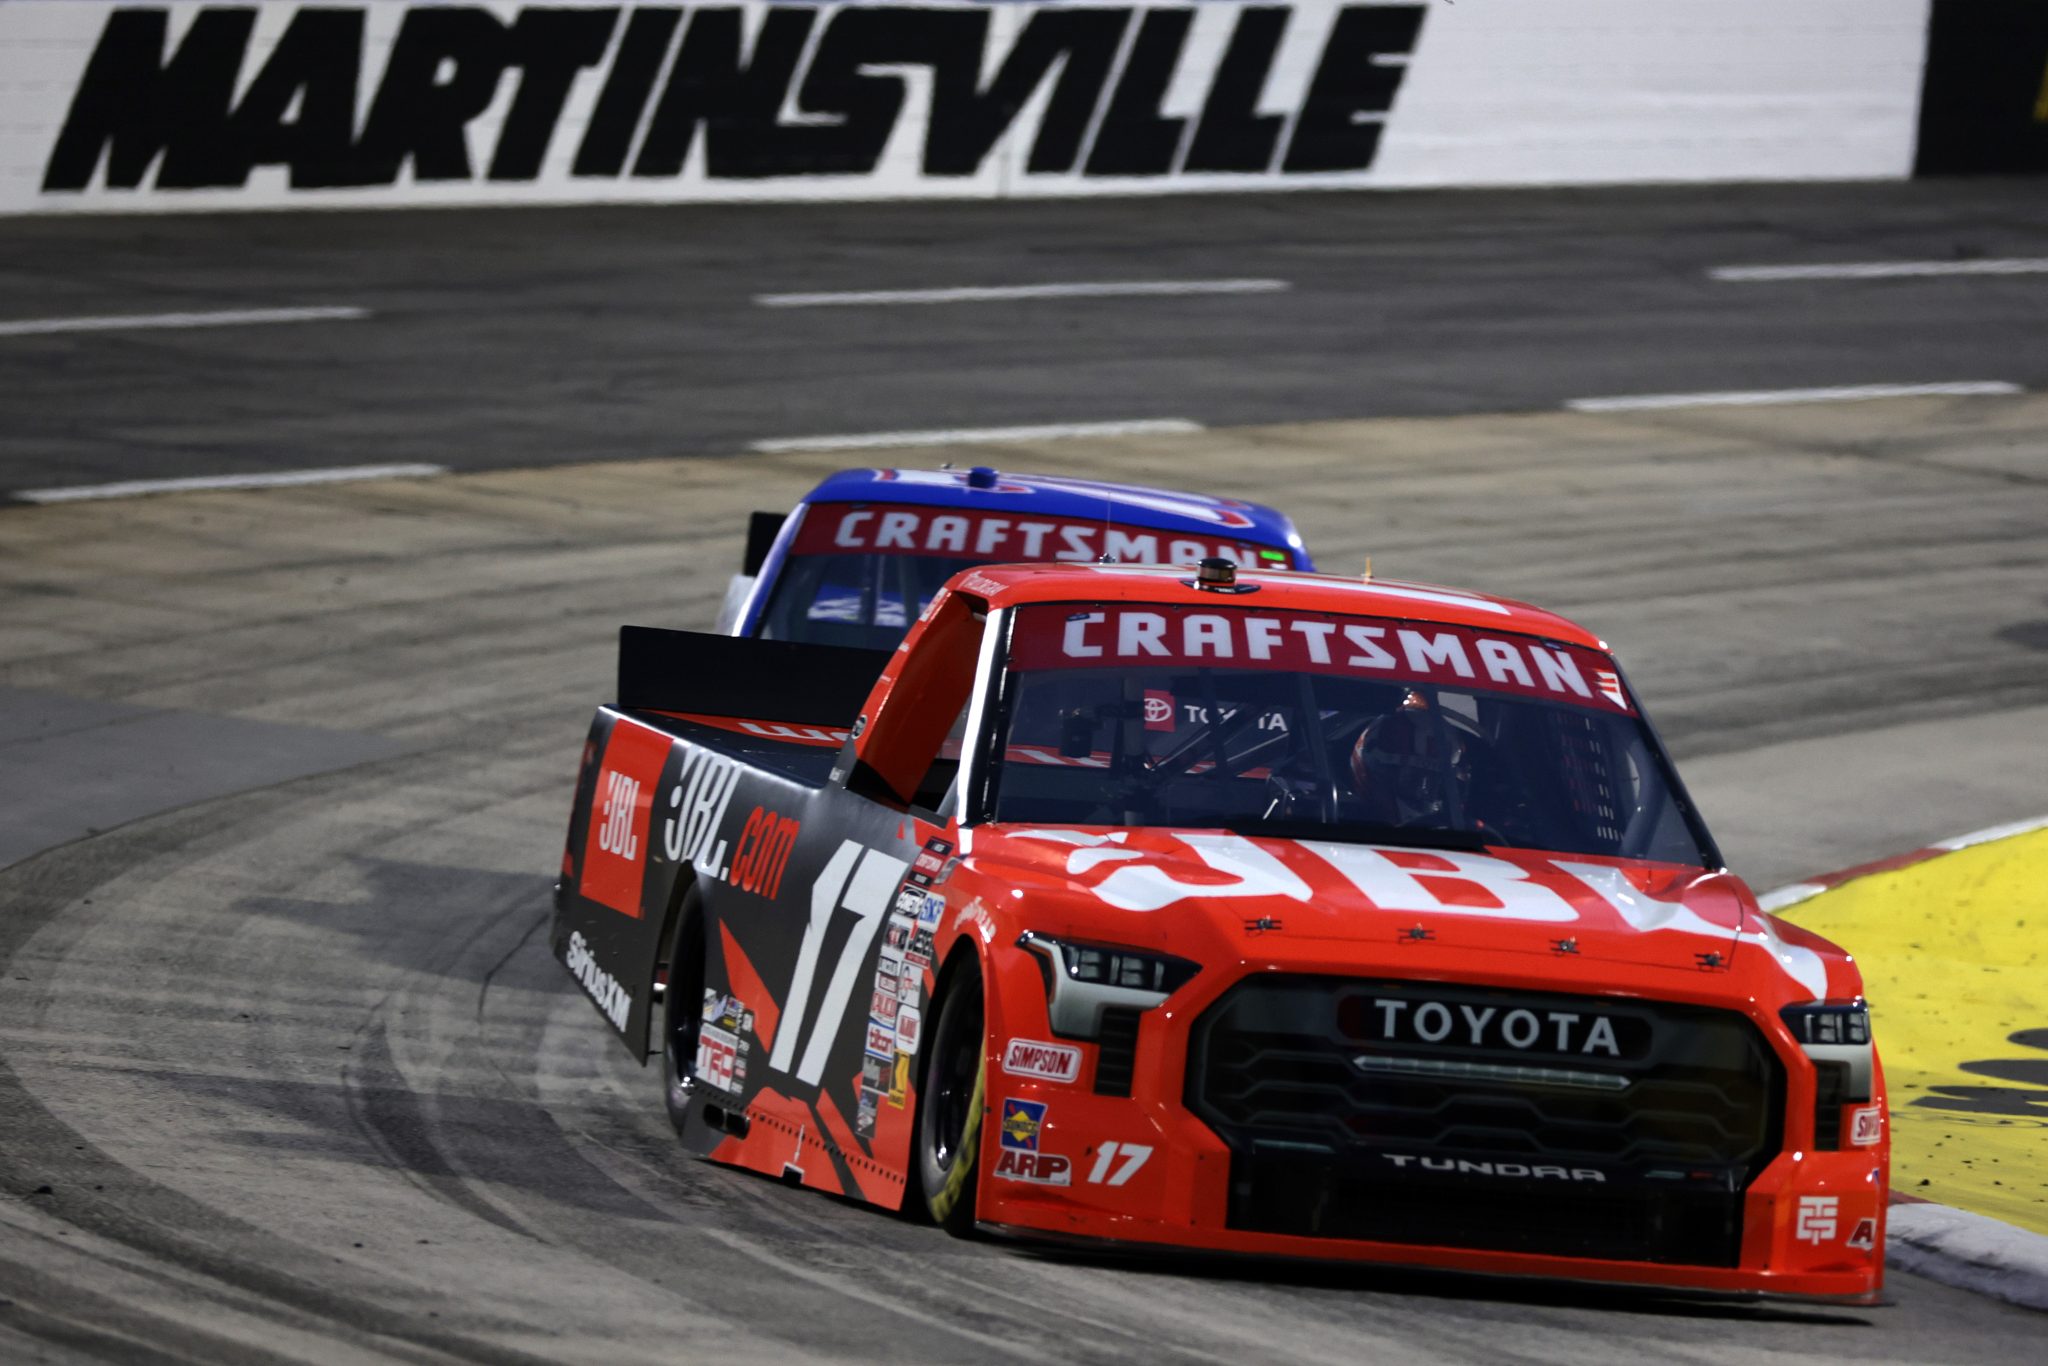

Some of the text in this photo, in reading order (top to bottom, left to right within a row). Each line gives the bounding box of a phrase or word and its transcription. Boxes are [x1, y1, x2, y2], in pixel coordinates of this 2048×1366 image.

[41, 5, 1427, 191] MARTINSVILLE
[1062, 611, 1594, 699] CRAFTSMAN
[600, 770, 640, 861] JBL
[664, 744, 801, 901] JBL.com
[1005, 829, 1828, 1006] JBL
[566, 930, 632, 1033] SiriusXM
[769, 838, 909, 1088] 17
[1009, 1045, 1072, 1075] SIMPSON
[1375, 999, 1620, 1056] TOYOTA
[998, 1150, 1069, 1180] ARP
[1087, 1140, 1154, 1187] 17
[1382, 1153, 1607, 1182] TUNDRA
